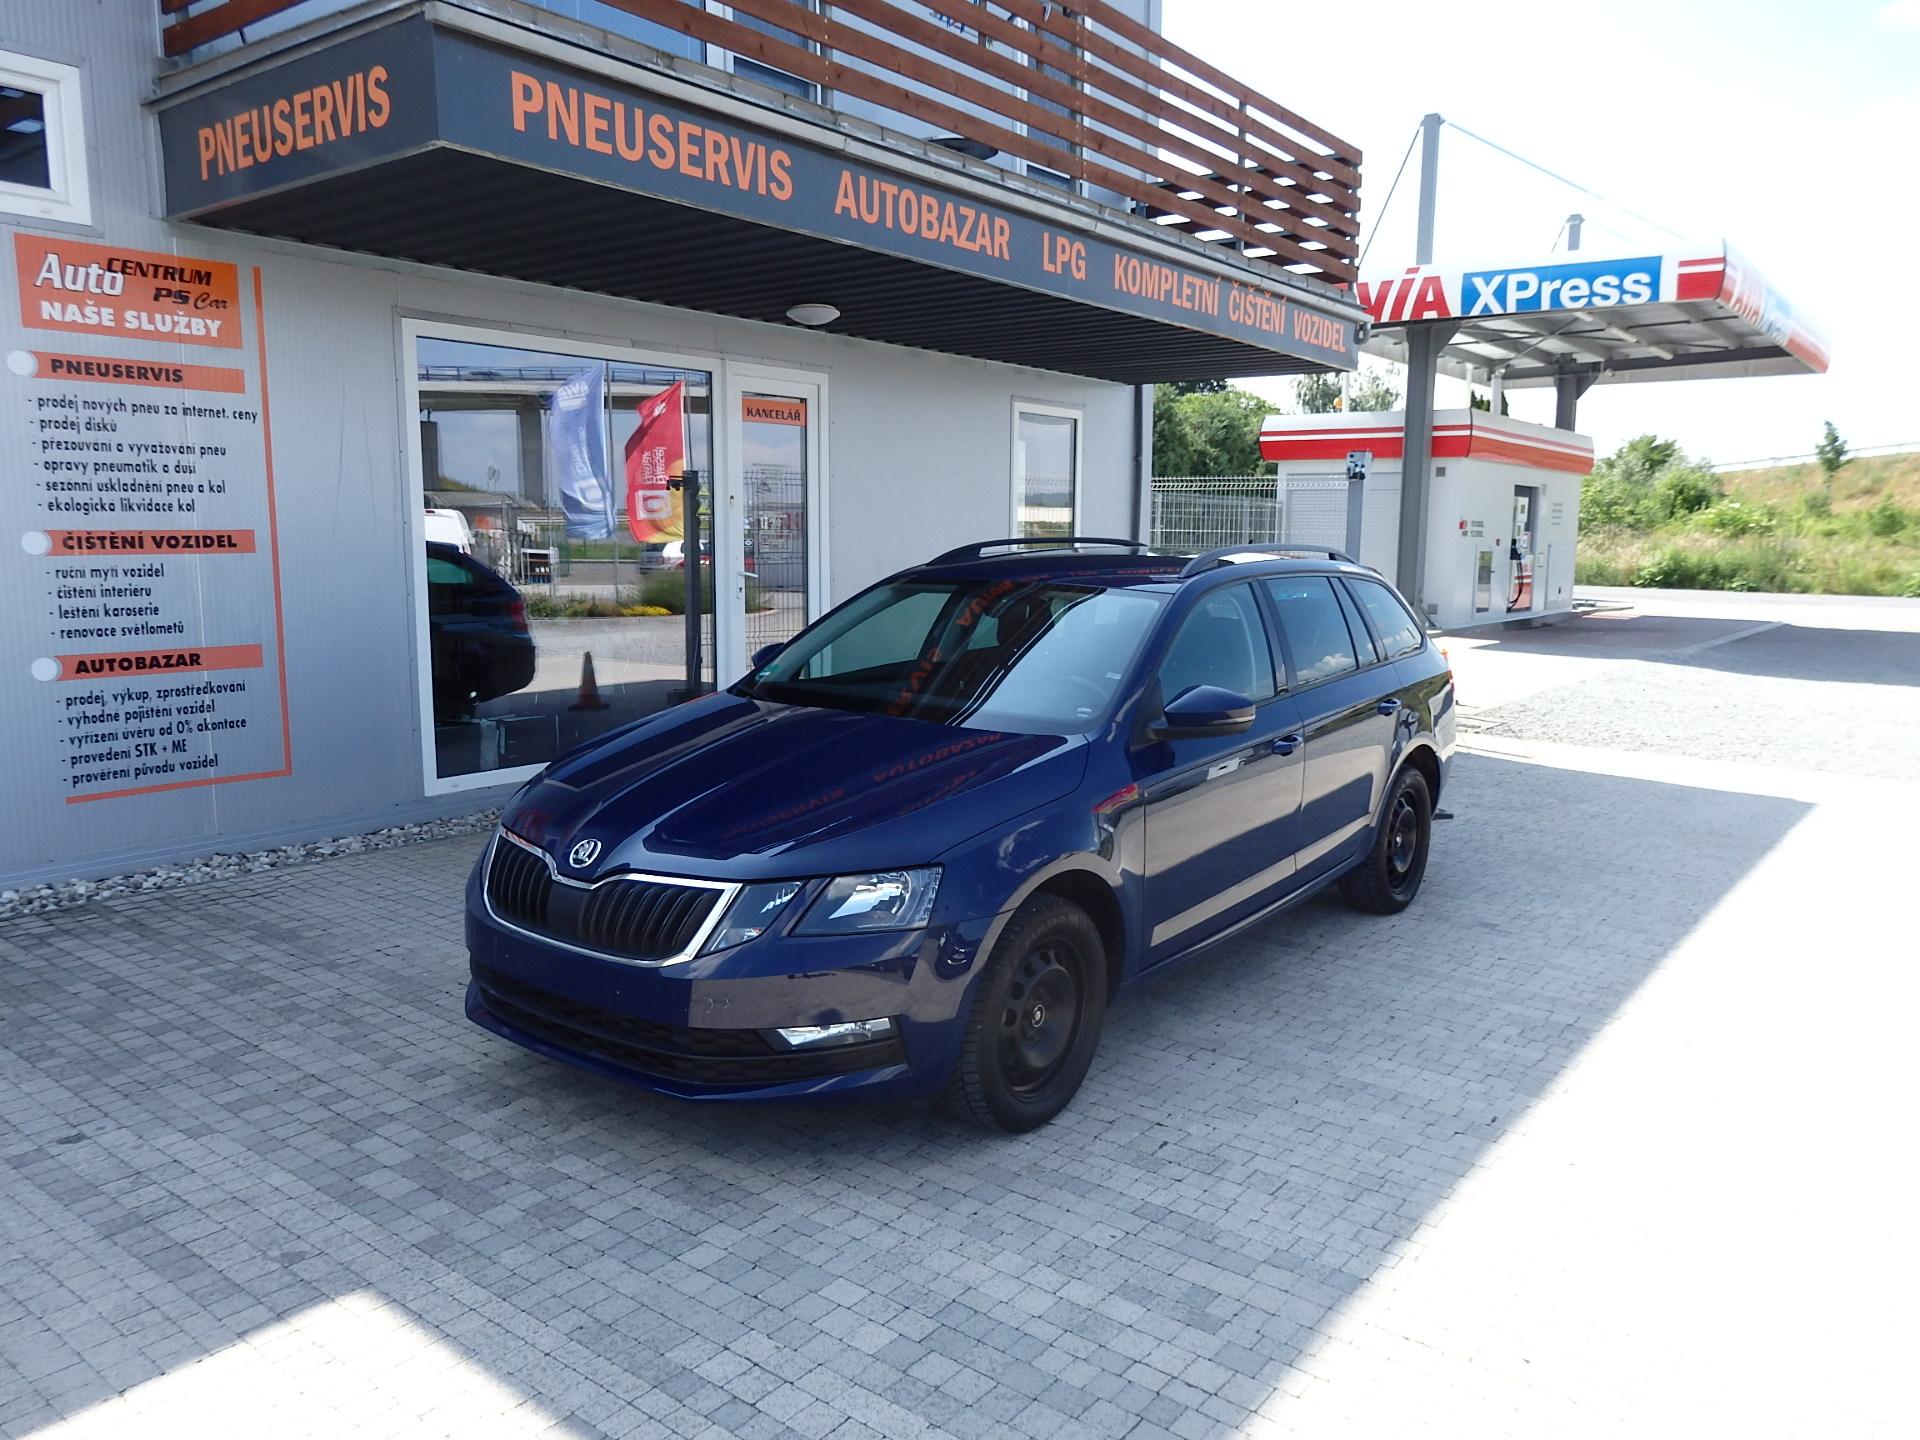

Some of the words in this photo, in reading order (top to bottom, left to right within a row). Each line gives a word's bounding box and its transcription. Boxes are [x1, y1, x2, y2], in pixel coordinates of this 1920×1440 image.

[197, 65, 391, 181] PNEUSERVIS
[510, 70, 793, 201] PNEUSERVIS
[834, 169, 1011, 261] AUTOBAZAR
[1042, 231, 1087, 281] LPG
[1114, 253, 1220, 317] KOMPLETNÍ
[1229, 280, 1287, 336] ČIŠTĚNÍ
[1293, 308, 1347, 353] VOZIDEL
[34, 252, 125, 296] Auto
[107, 257, 213, 286] CENTRUM
[153, 287, 191, 305] PS
[1469, 269, 1653, 315] XPress
[40, 300, 116, 328] NAŠE
[124, 309, 223, 338] SLUŽBY
[50, 358, 184, 383] PNEUSERVIS
[38, 394, 79, 413] prodej
[83, 397, 127, 415] nových
[132, 402, 160, 416] pneu
[164, 404, 178, 415] za
[233, 409, 258, 424] ceny
[746, 407, 801, 422] KANCELÁŘ
[40, 415, 80, 434] prodej
[116, 443, 123, 452] a
[200, 446, 227, 458] pneu
[44, 461, 88, 475] opravy
[93, 459, 158, 475] pneumatik
[162, 464, 169, 473] a
[166, 482, 194, 496] pneu
[198, 484, 204, 493] a
[208, 479, 226, 493] kol
[120, 497, 173, 512] likvidace
[178, 498, 195, 512] kol
[62, 531, 145, 550] ČIŠTĚNÍ
[151, 534, 237, 549] VOZIDEL
[122, 562, 165, 578] vozidel
[103, 602, 160, 618] karoserie
[60, 625, 117, 639] renovace
[75, 653, 202, 674] AUTOBAZAR
[176, 699, 215, 716] vozidel
[159, 722, 173, 736] od
[176, 719, 193, 734] 0%
[197, 718, 247, 732] akontace
[135, 742, 158, 758] STK
[161, 745, 167, 753] +
[172, 738, 187, 753] ME
[179, 753, 218, 771] vozidel
